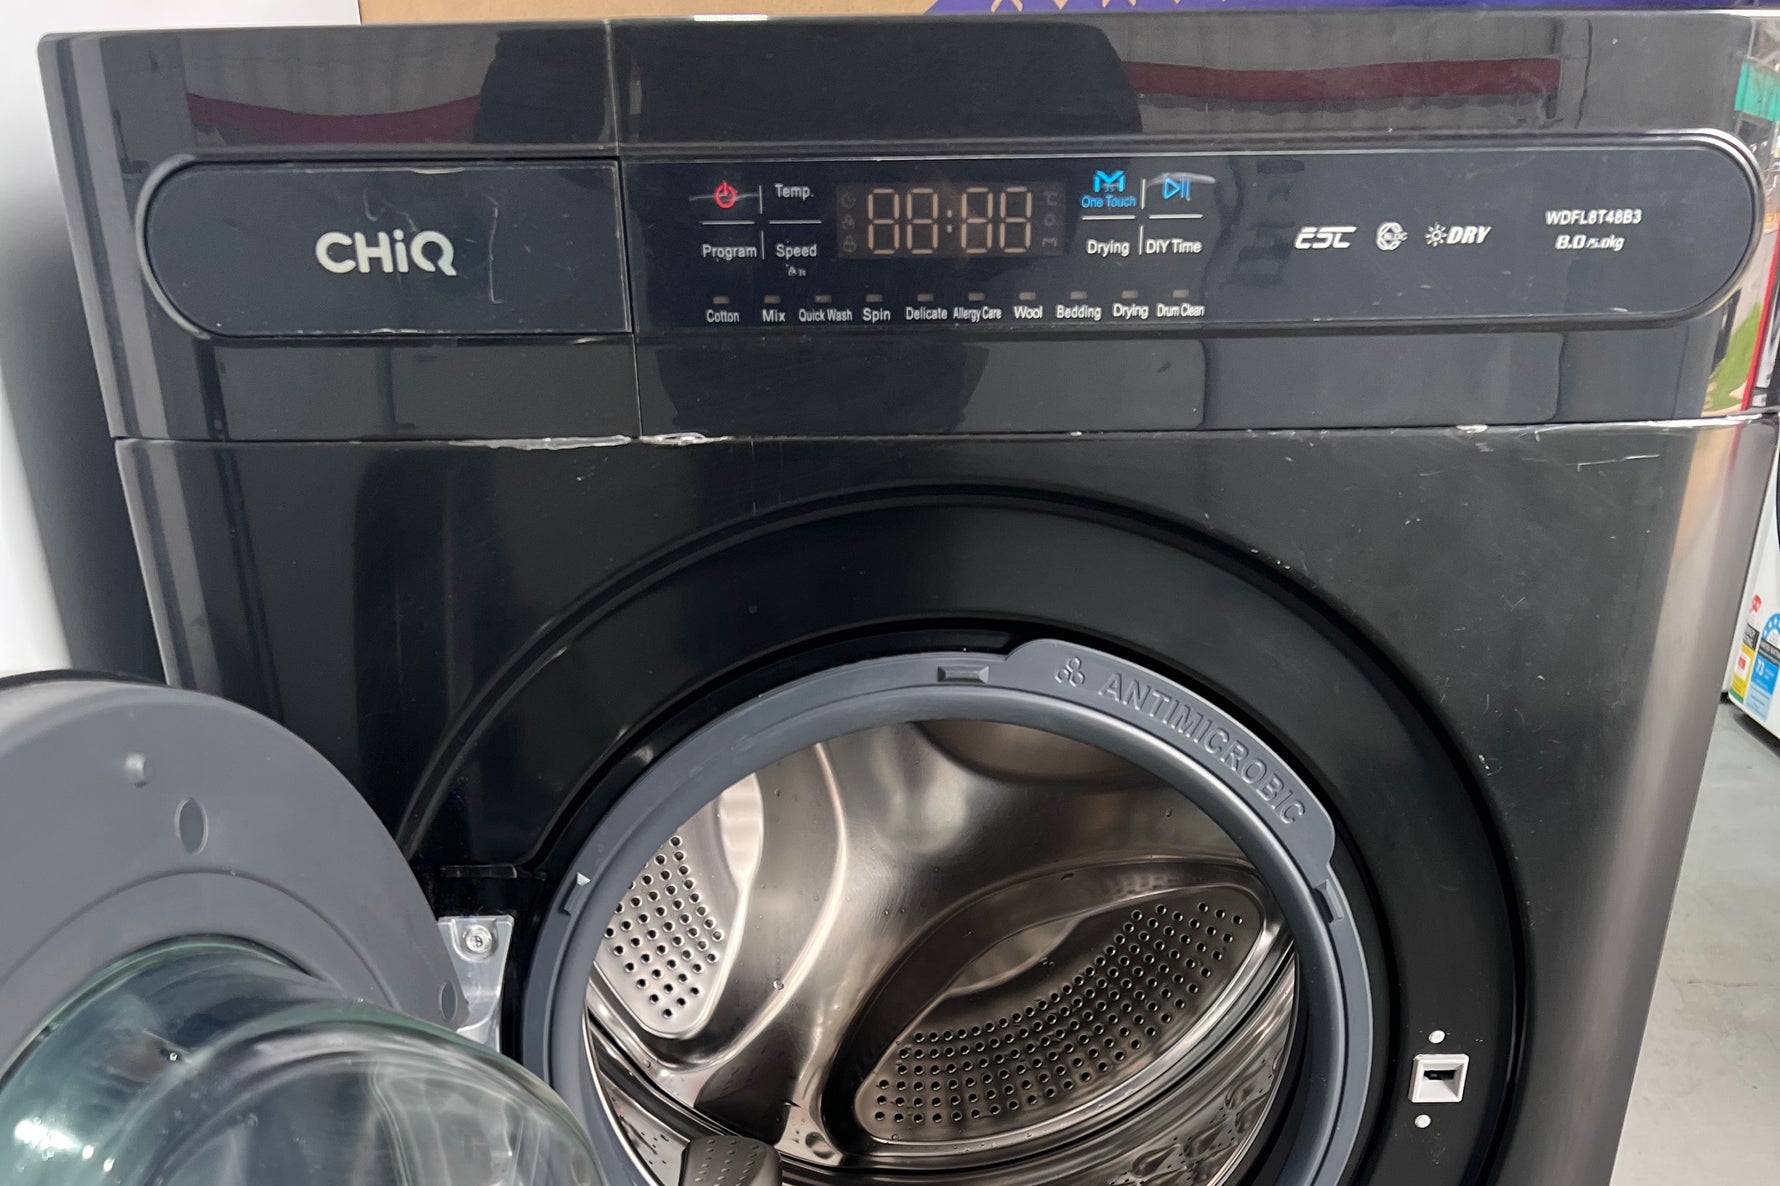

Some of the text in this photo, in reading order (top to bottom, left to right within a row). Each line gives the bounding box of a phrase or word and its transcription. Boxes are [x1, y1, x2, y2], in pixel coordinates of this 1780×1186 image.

[774, 183, 815, 201] Temp.
[1081, 194, 1137, 208] One Touch
[1545, 208, 1643, 225] WDFL8T48B3
[1446, 225, 1492, 245] DRY
[315, 228, 457, 277] CHiQ
[702, 243, 758, 261] Program
[775, 243, 818, 260] Speed
[1086, 239, 1131, 257] Drying
[1145, 238, 1202, 254] DIY Time
[706, 309, 740, 323] Cotton
[762, 308, 786, 322] Mix
[799, 307, 853, 322] Quick Wash
[862, 307, 892, 323] Spin
[905, 306, 948, 321] Delicate
[953, 306, 1002, 323] Allergy Care
[1014, 305, 1044, 320] Wool
[1056, 304, 1102, 321] Bedding
[1112, 303, 1149, 319] Drying
[1156, 302, 1206, 318] Drum Clean
[1097, 671, 1307, 825] ANTIMICROBIC
